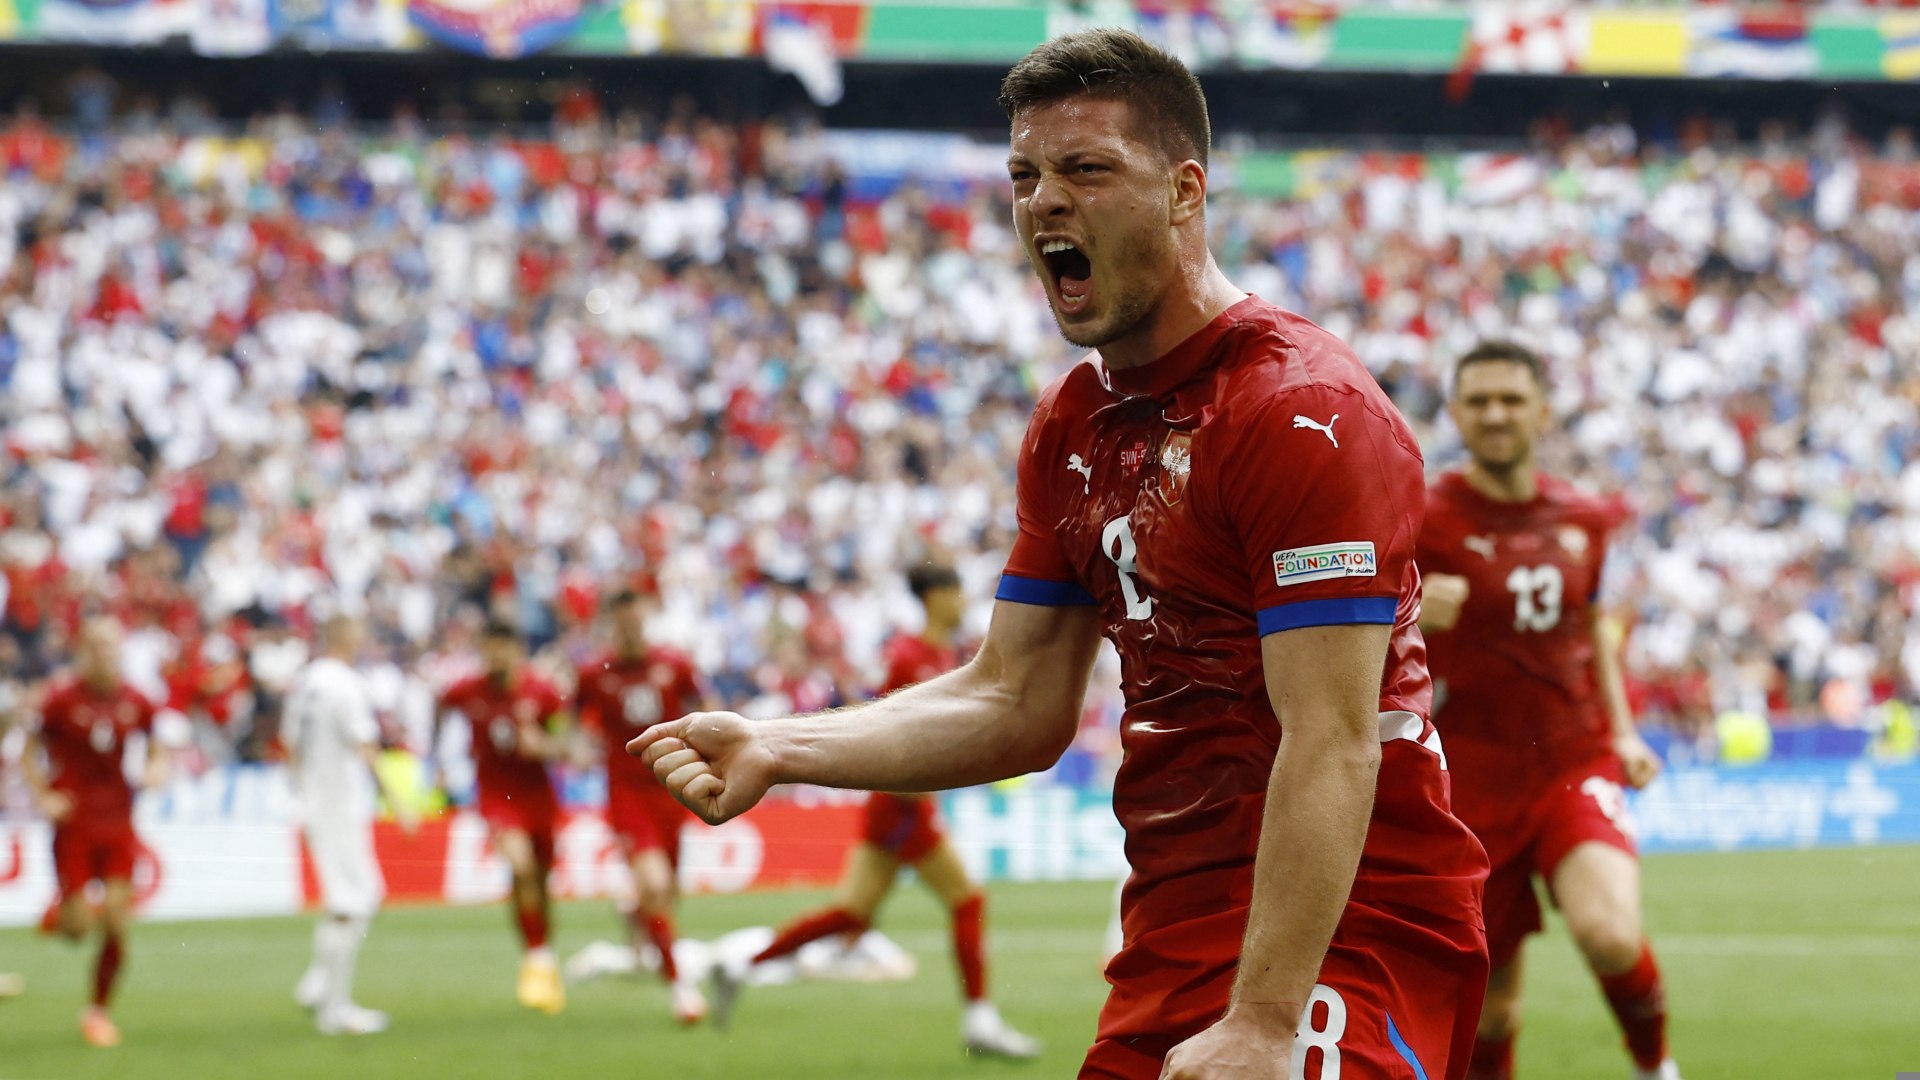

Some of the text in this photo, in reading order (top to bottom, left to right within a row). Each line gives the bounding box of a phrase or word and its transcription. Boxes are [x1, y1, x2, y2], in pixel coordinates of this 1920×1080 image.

[1275, 552, 1297, 562] UEFA
[1345, 566, 1354, 575] for
[1505, 564, 1564, 633] 13
[1288, 983, 1347, 1080] 8
